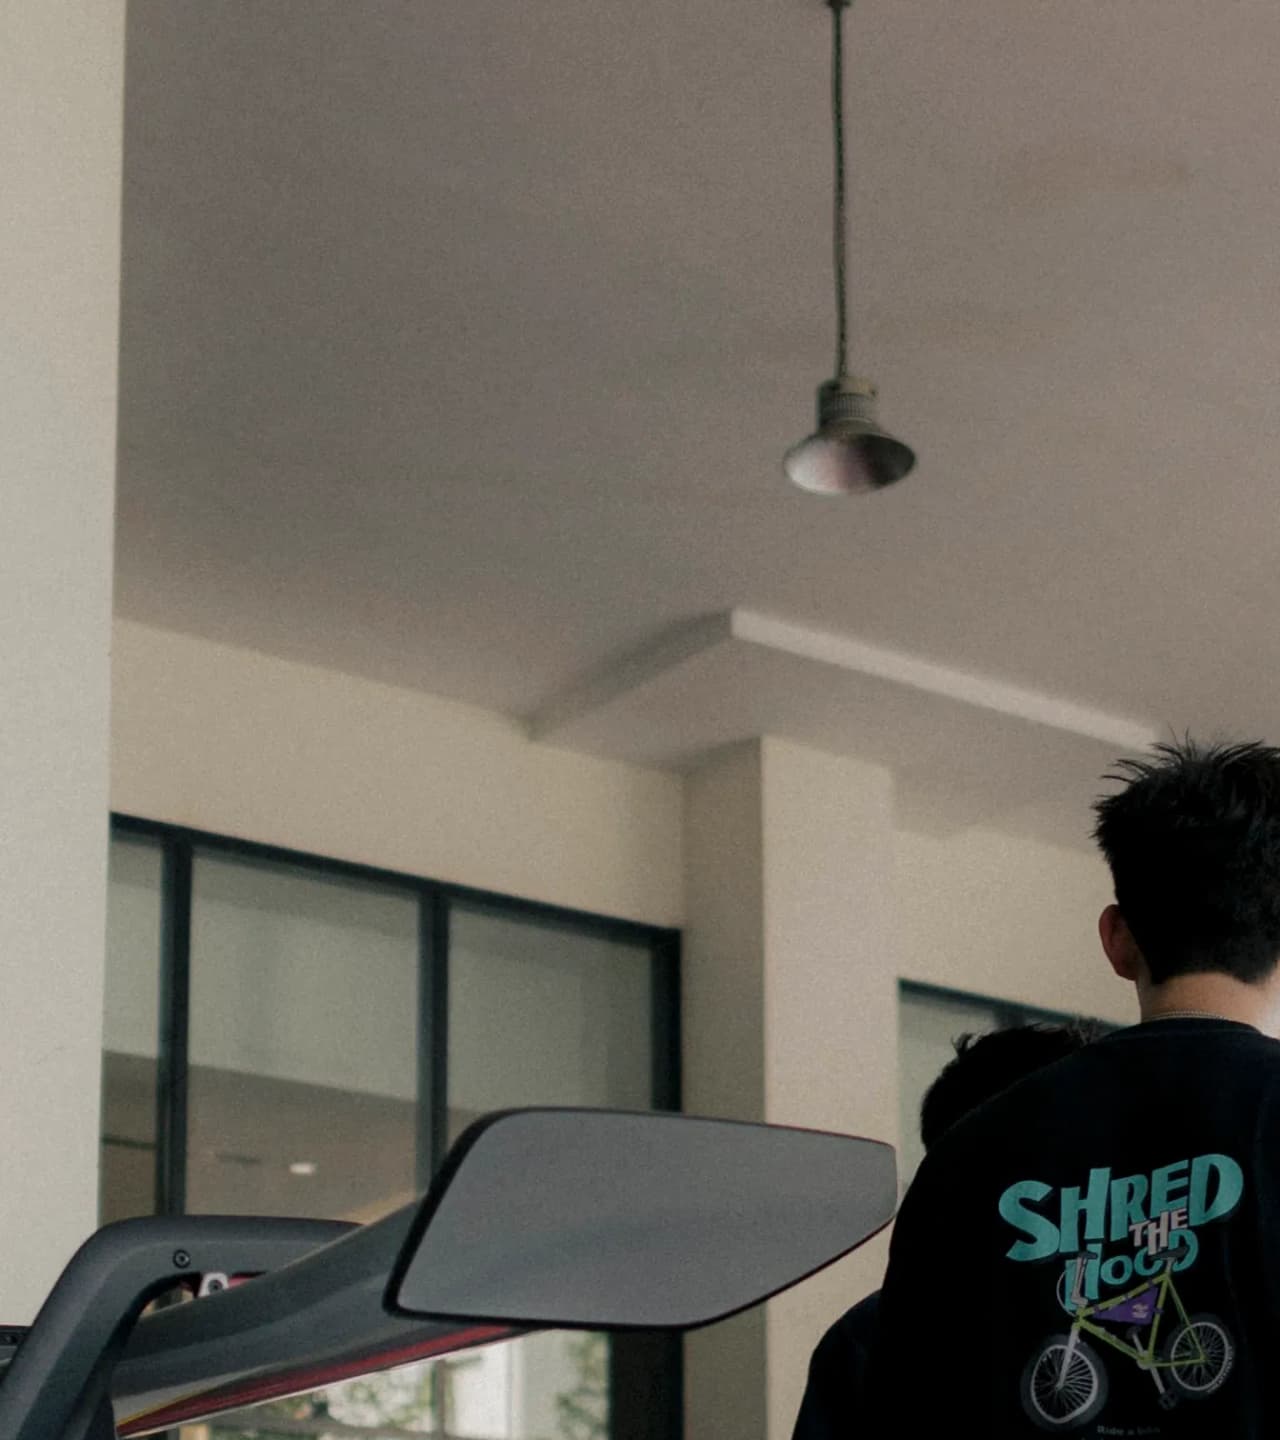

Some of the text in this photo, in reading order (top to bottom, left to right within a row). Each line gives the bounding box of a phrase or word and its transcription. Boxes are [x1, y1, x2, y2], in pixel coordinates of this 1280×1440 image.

[998, 1153, 1245, 1262] SHRED
[1129, 1208, 1189, 1256] THE
[1064, 1229, 1200, 1312] HOOD
